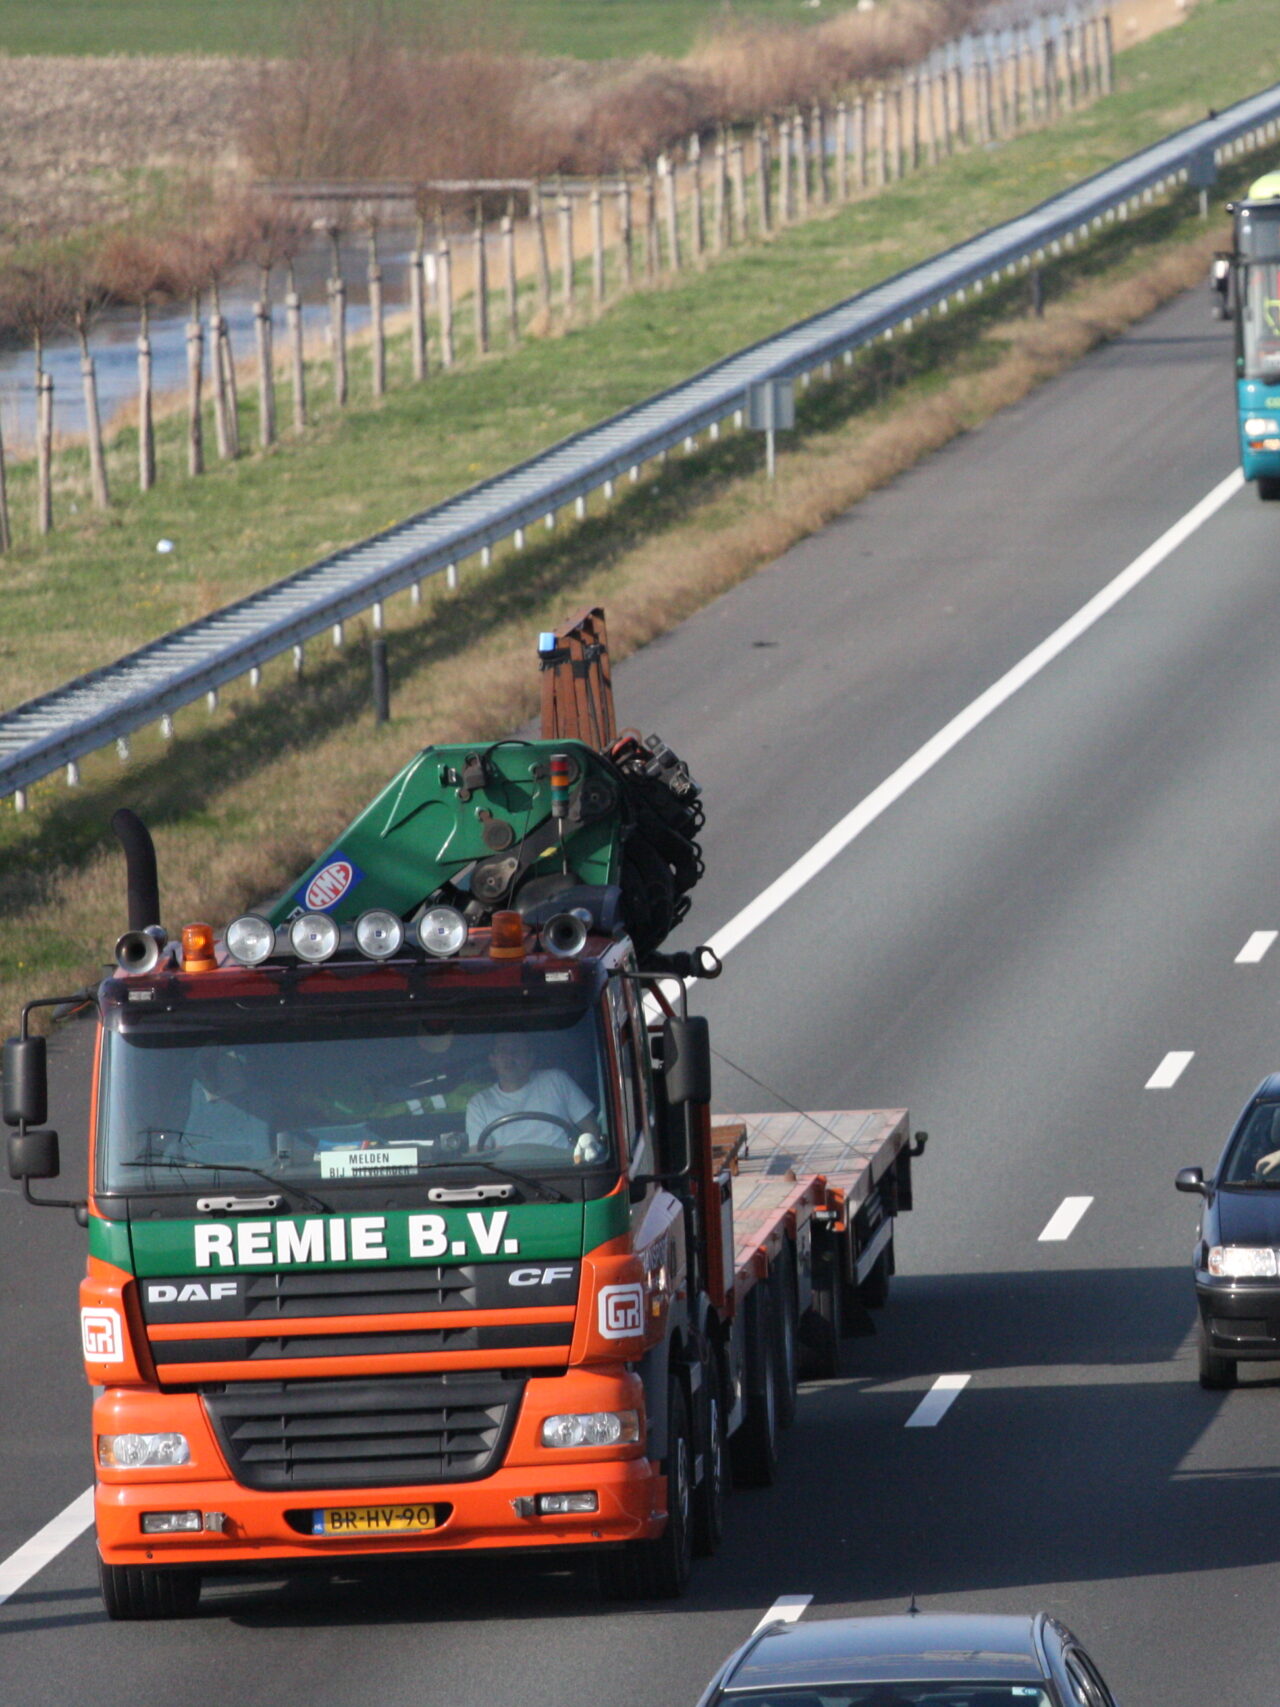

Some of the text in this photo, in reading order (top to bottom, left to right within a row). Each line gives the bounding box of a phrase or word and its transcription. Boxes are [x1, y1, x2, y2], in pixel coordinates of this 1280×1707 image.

[309, 864, 350, 906] HMF
[348, 1152, 390, 1165] MELDEN
[329, 1167, 345, 1178] BIJ
[194, 1210, 519, 1268] REMIE B.V.
[508, 1266, 574, 1287] CF
[148, 1282, 238, 1303] DAF
[330, 1507, 430, 1529] BR-HV-90
